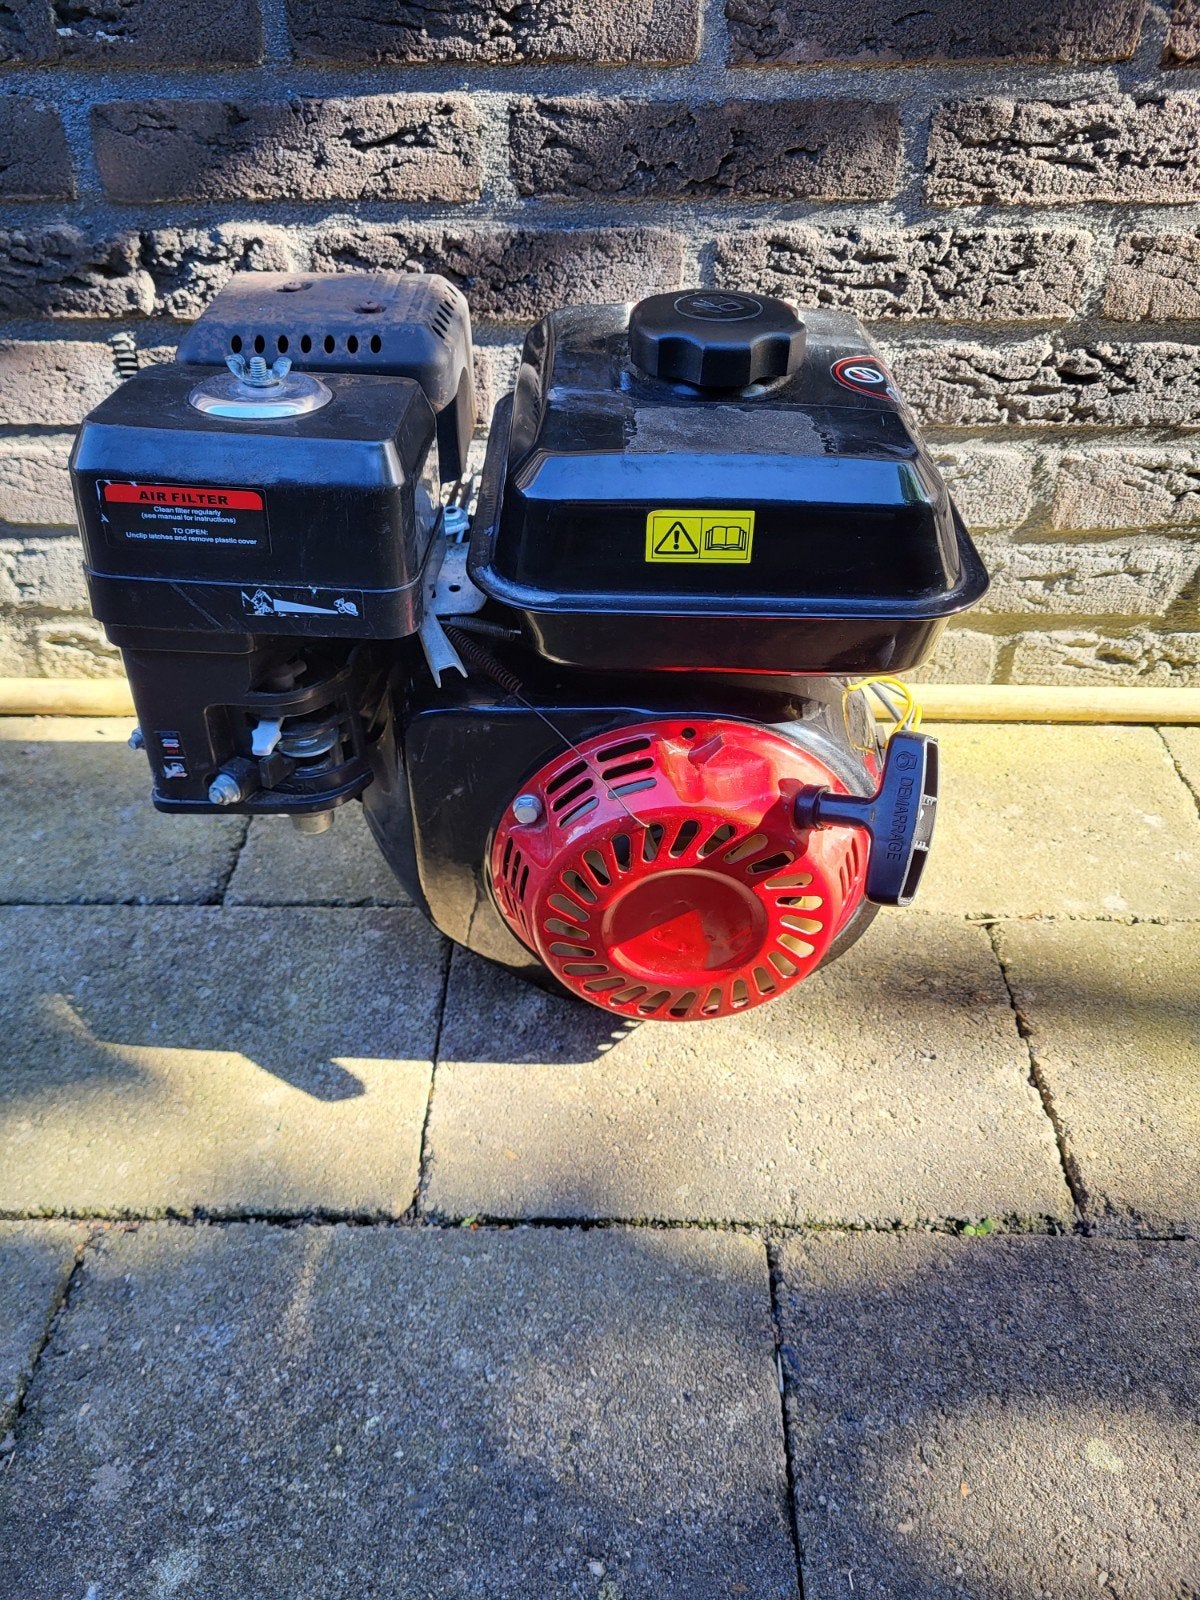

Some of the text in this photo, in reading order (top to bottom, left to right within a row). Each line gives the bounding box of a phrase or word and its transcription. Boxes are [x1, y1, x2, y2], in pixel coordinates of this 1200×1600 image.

[139, 490, 229, 506] AIR FILTER
[141, 512, 157, 520] (see
[194, 515, 236, 524] instructions)
[191, 509, 221, 517] regularly
[125, 531, 148, 540] Unclip
[148, 533, 173, 541] latches
[214, 536, 238, 544] plastic
[184, 528, 209, 536] OPEN:
